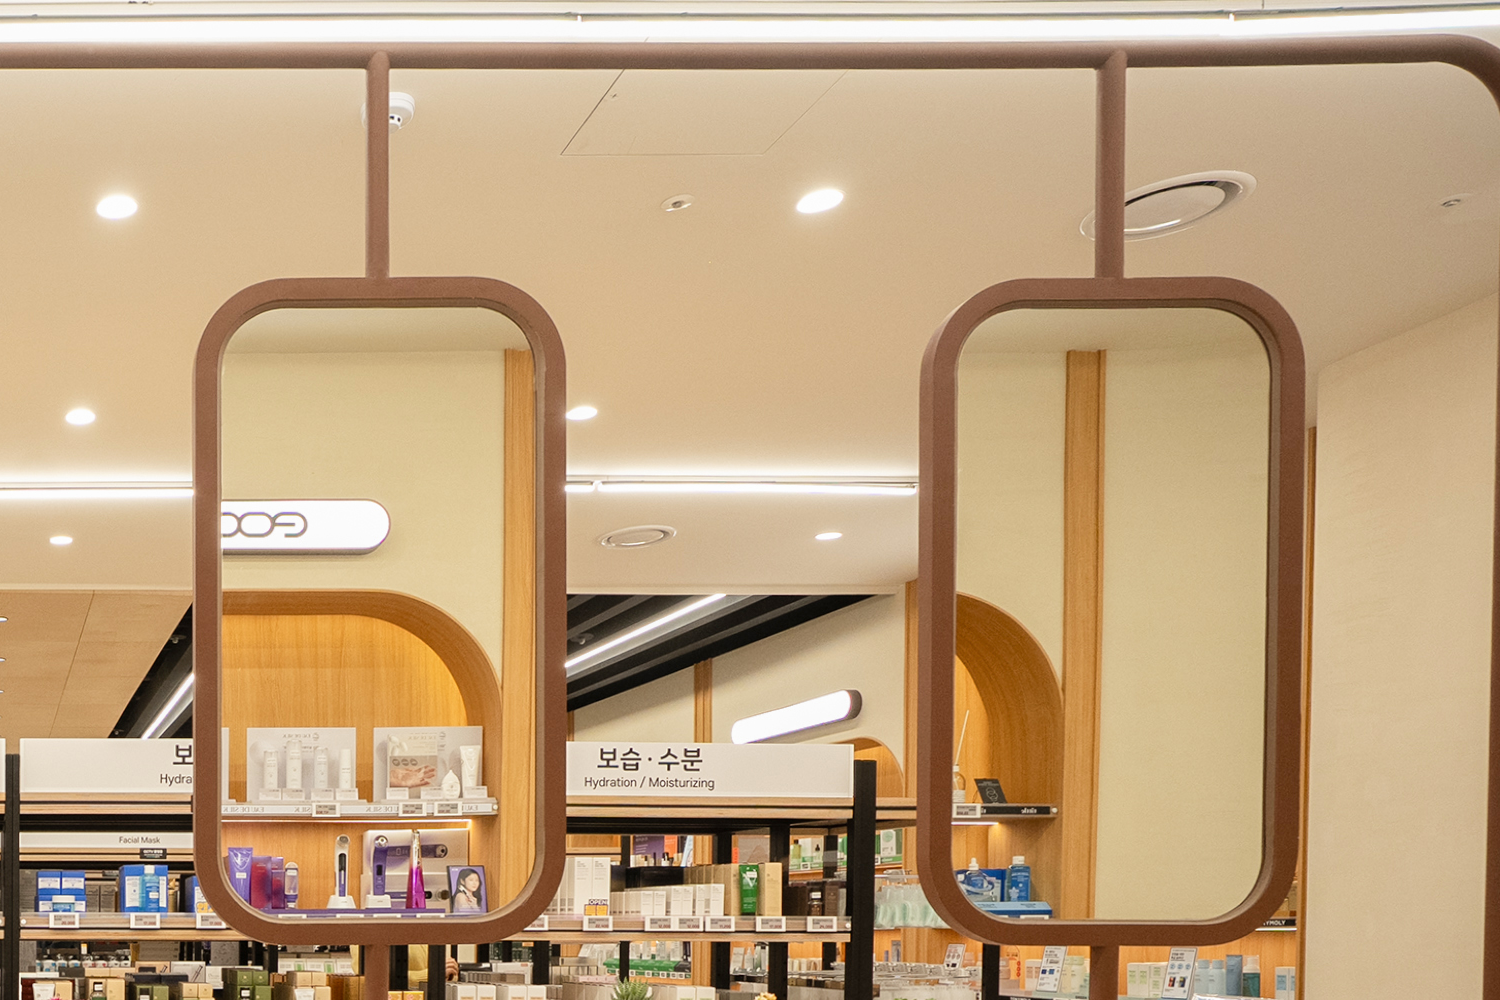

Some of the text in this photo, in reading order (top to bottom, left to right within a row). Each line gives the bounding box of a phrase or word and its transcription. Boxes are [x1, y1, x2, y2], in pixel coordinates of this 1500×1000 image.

[658, 747, 703, 772] 수분
[160, 773, 193, 787] Hydra
[584, 777, 637, 790] Hydration
[648, 777, 715, 791] Moisturizing
[119, 836, 161, 844] Facial Mask
